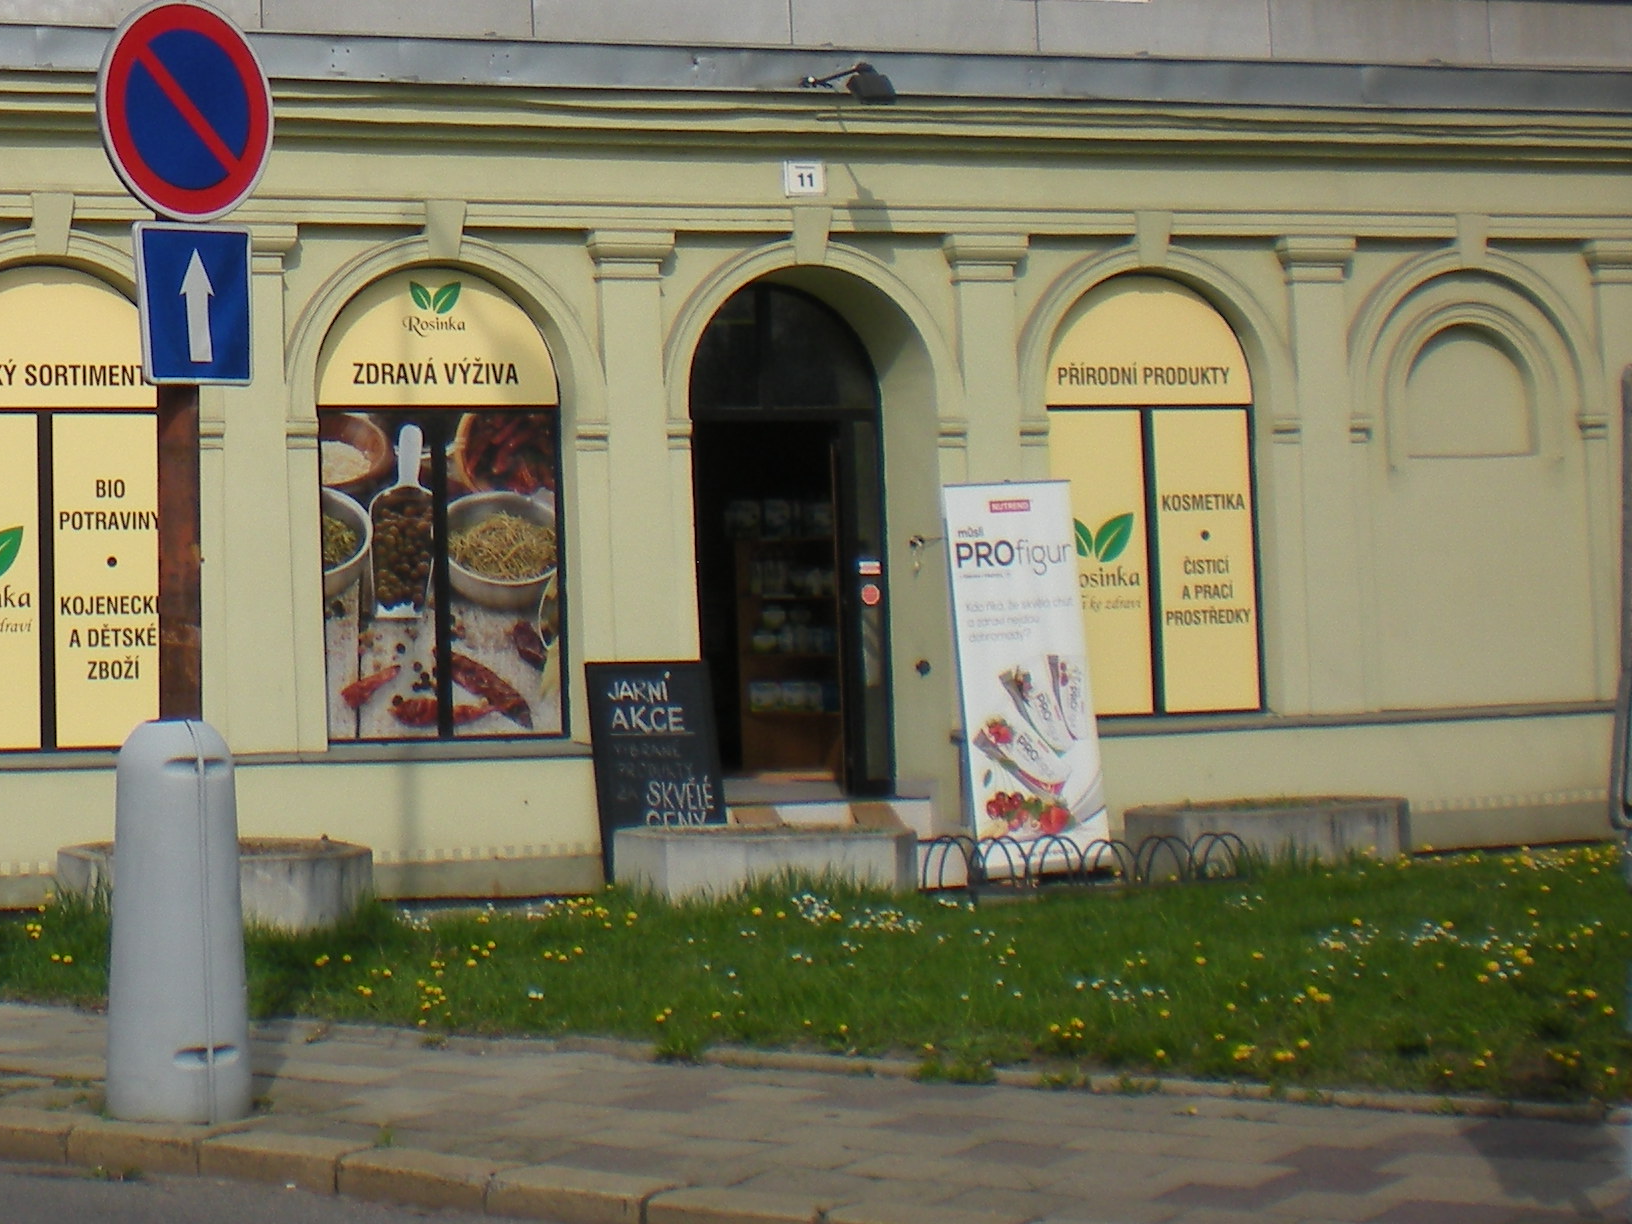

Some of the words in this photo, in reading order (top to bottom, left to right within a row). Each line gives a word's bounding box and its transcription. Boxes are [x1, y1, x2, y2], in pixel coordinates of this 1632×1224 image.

[797, 172, 814, 188] 11
[402, 315, 467, 338] Rosinka
[352, 358, 438, 386] ZDRAVÁ
[443, 355, 519, 385] VÝŽIVA
[1057, 362, 1138, 385] PŘÍRODNÍ
[1143, 366, 1230, 385] PRODUKTY
[95, 479, 125, 498] BIO
[991, 501, 1029, 512] NUTREND
[1162, 493, 1246, 512] KOSMETIKA
[955, 539, 1073, 576] PROfigur
[1183, 557, 1230, 575] ČISTICÍ
[1079, 565, 1141, 589] osinka
[1181, 584, 1192, 599] A
[1193, 580, 1234, 599] PRACÍ
[1165, 605, 1252, 626] PROSTŘEDKY
[69, 629, 82, 648] A
[87, 623, 157, 647] DĚTSKÉ
[87, 655, 140, 680] ZBOŽÍ
[612, 706, 686, 734] AKCE
[646, 775, 715, 811] SKVĚLÉ
